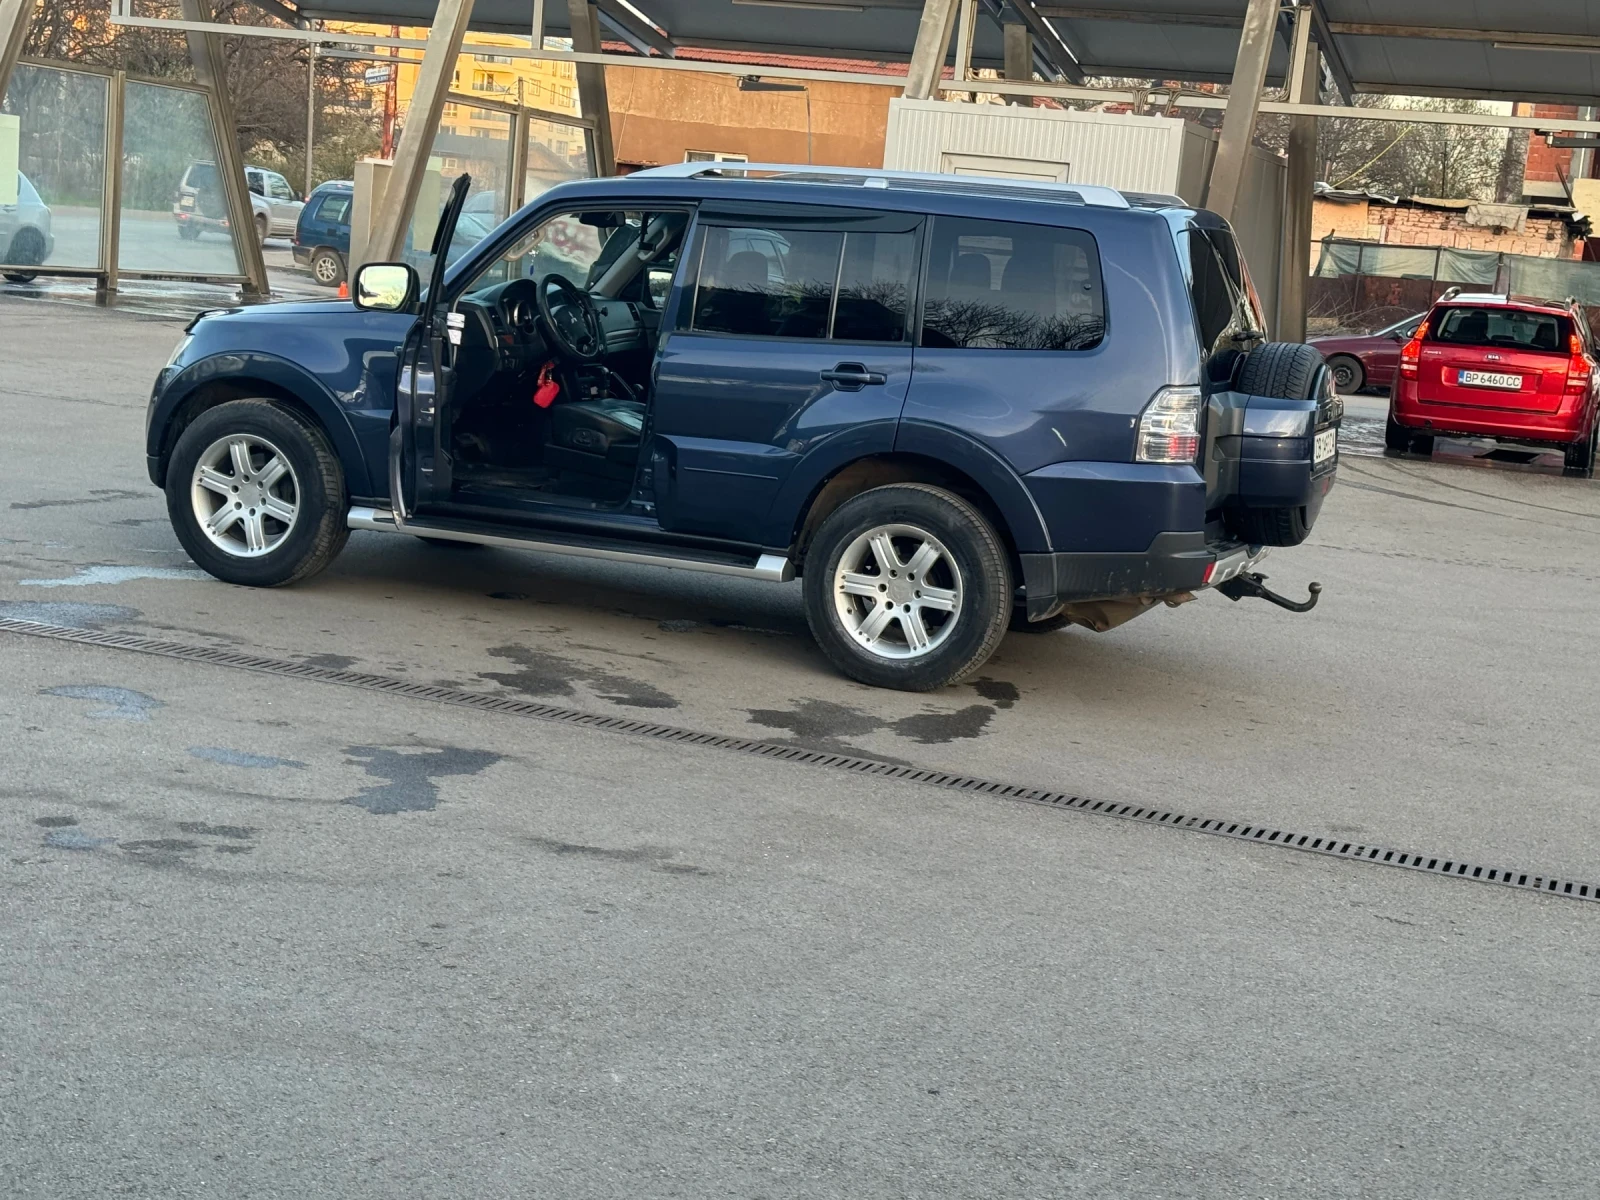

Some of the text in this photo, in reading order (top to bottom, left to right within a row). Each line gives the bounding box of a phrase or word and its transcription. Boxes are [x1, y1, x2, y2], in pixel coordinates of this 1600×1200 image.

[1465, 372, 1520, 387] BP 6460 CC
